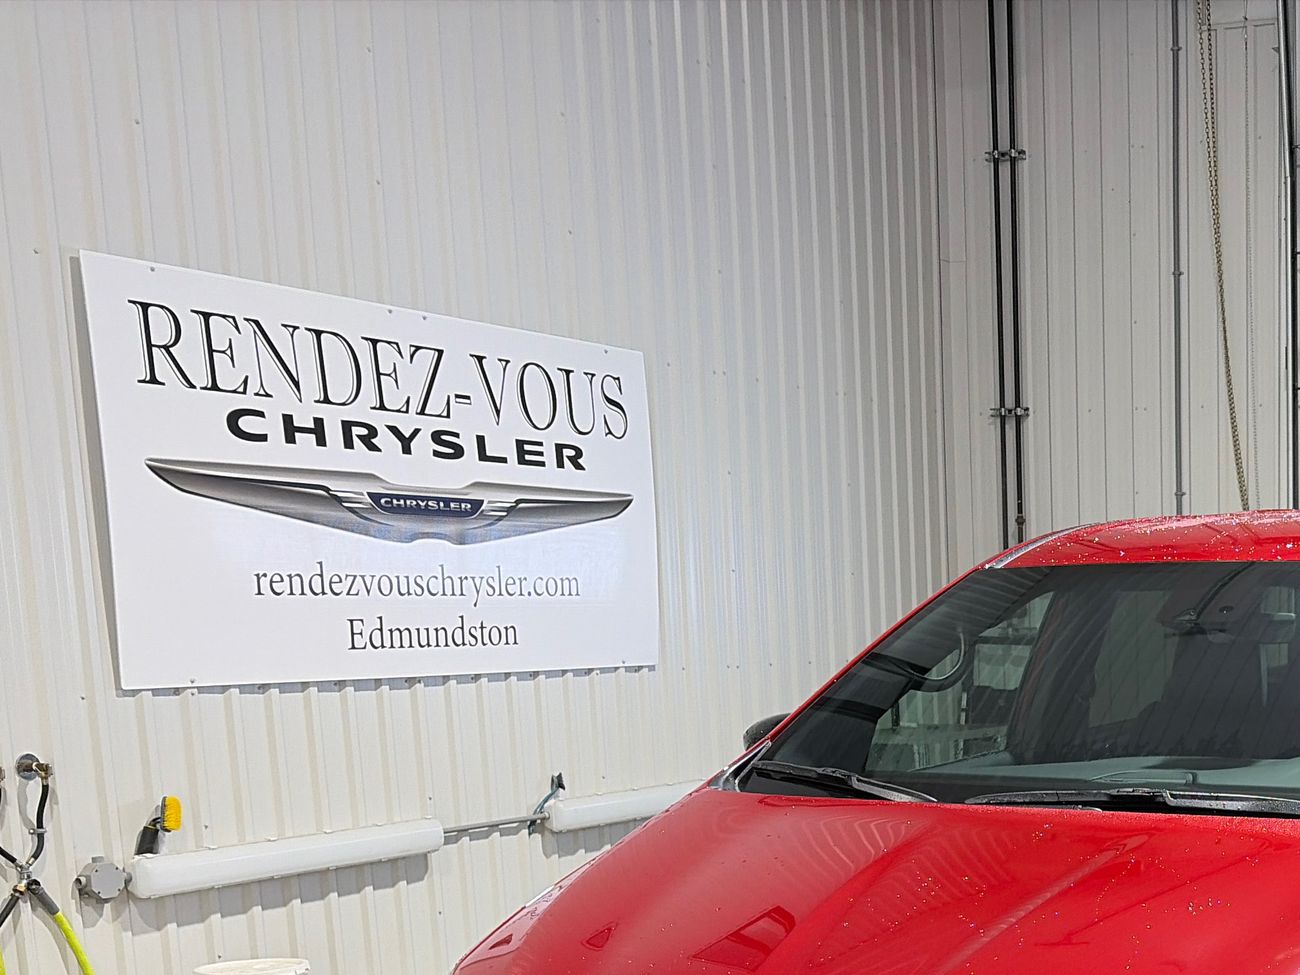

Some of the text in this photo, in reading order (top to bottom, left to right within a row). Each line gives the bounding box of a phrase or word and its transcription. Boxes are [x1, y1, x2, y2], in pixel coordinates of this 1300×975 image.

[127, 298, 629, 440] RENDEZ-VOUS
[225, 408, 587, 471] CHRYSLER
[380, 497, 472, 512] CHRYSLER
[253, 561, 581, 607] rendezvouschrysler.com
[347, 615, 519, 650] Edmundston
